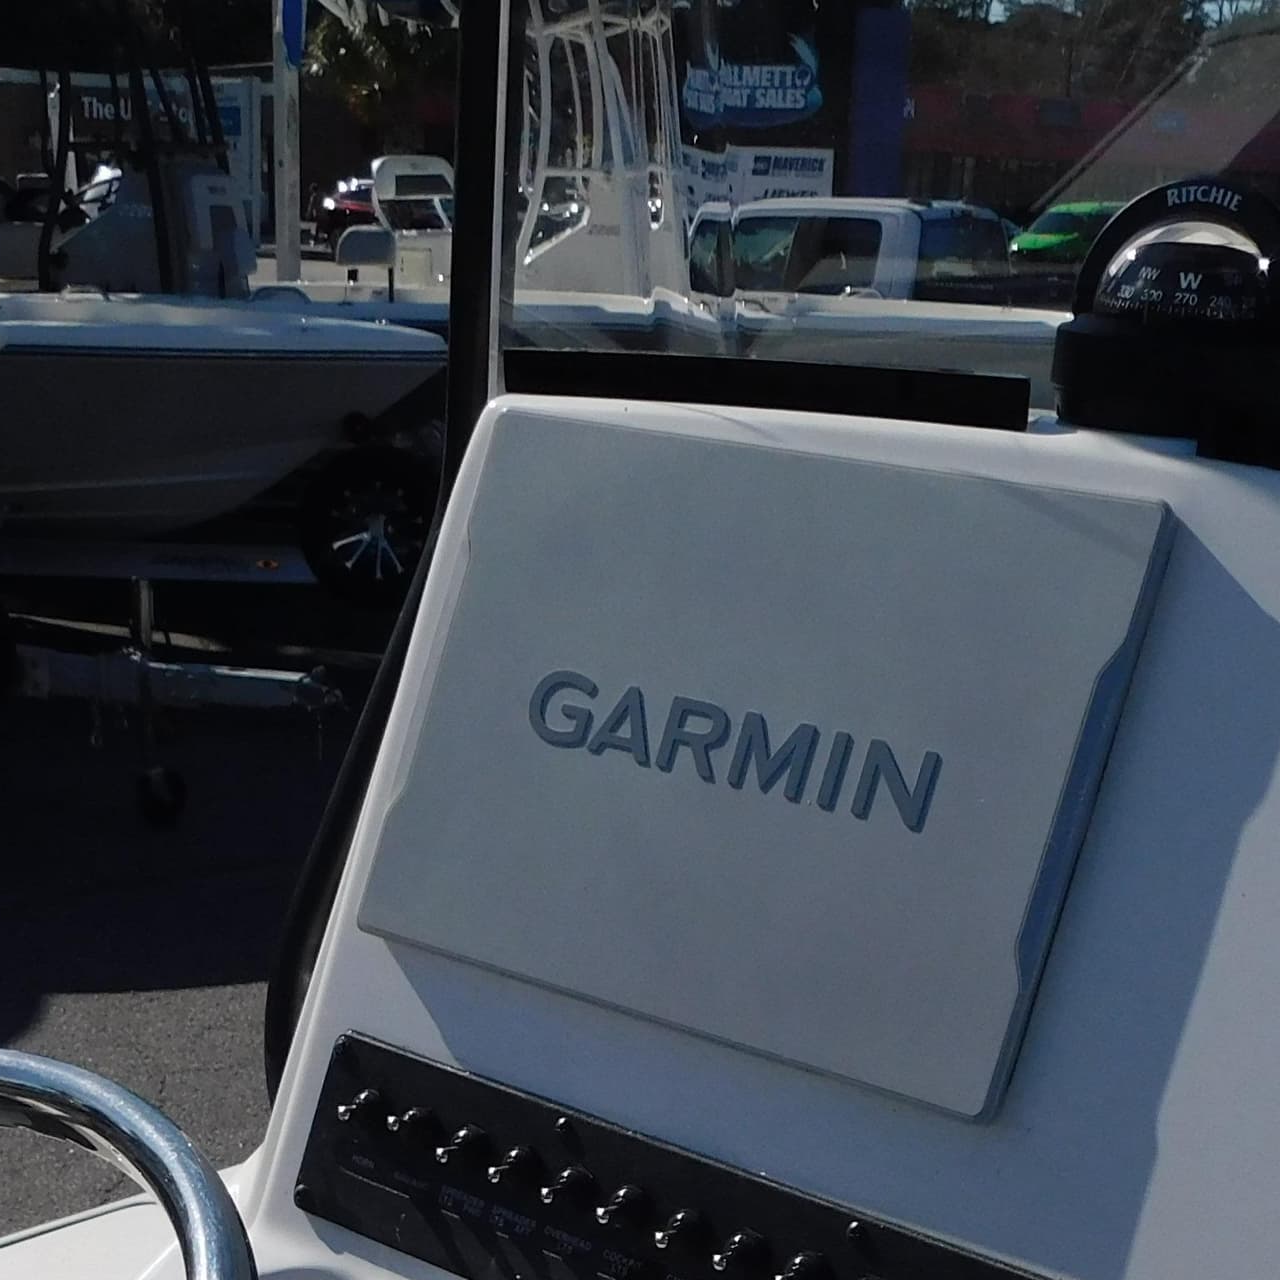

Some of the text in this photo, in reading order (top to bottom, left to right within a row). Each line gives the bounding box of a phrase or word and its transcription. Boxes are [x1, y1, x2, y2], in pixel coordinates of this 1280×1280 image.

[81, 96, 115, 120] The
[754, 88, 807, 109] SALES
[772, 156, 826, 172] MAVERICK
[1166, 185, 1242, 212] RITCHIE
[1179, 271, 1203, 290] W
[1174, 291, 1198, 307] 270
[528, 670, 943, 834] GARMIN
